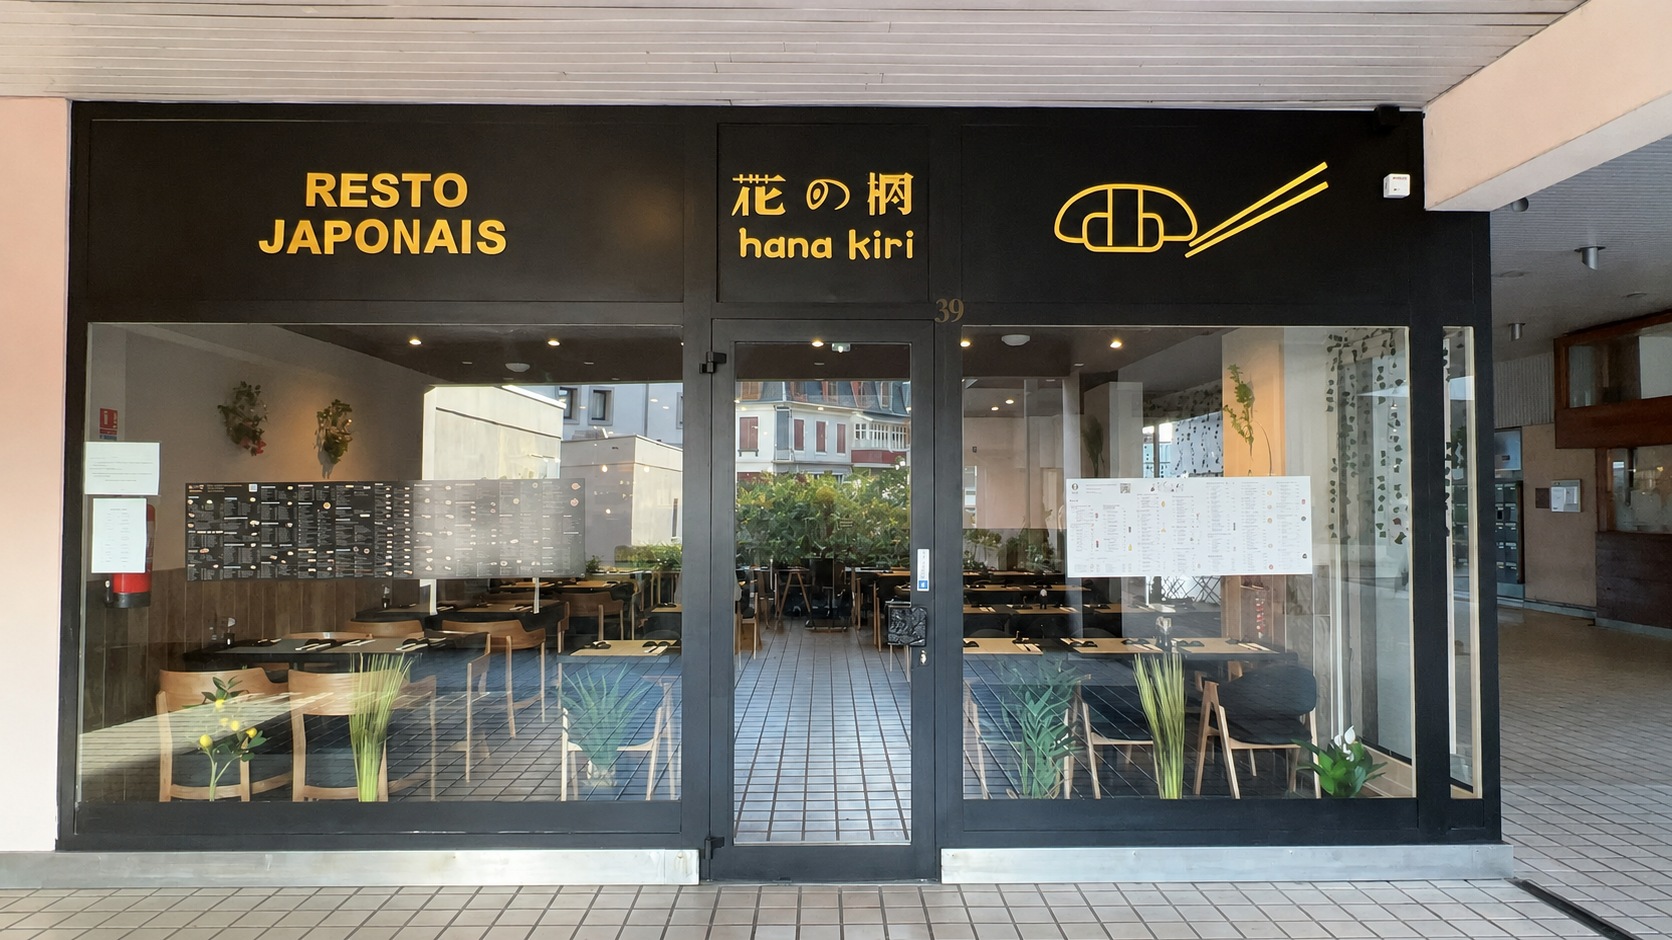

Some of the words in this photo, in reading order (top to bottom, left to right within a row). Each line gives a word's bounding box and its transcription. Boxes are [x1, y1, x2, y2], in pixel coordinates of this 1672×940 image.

[305, 172, 468, 208] RESTO
[258, 218, 507, 255] JAPONAIS
[738, 227, 833, 259] hana
[848, 228, 915, 261] kiri
[934, 298, 965, 323] 39
